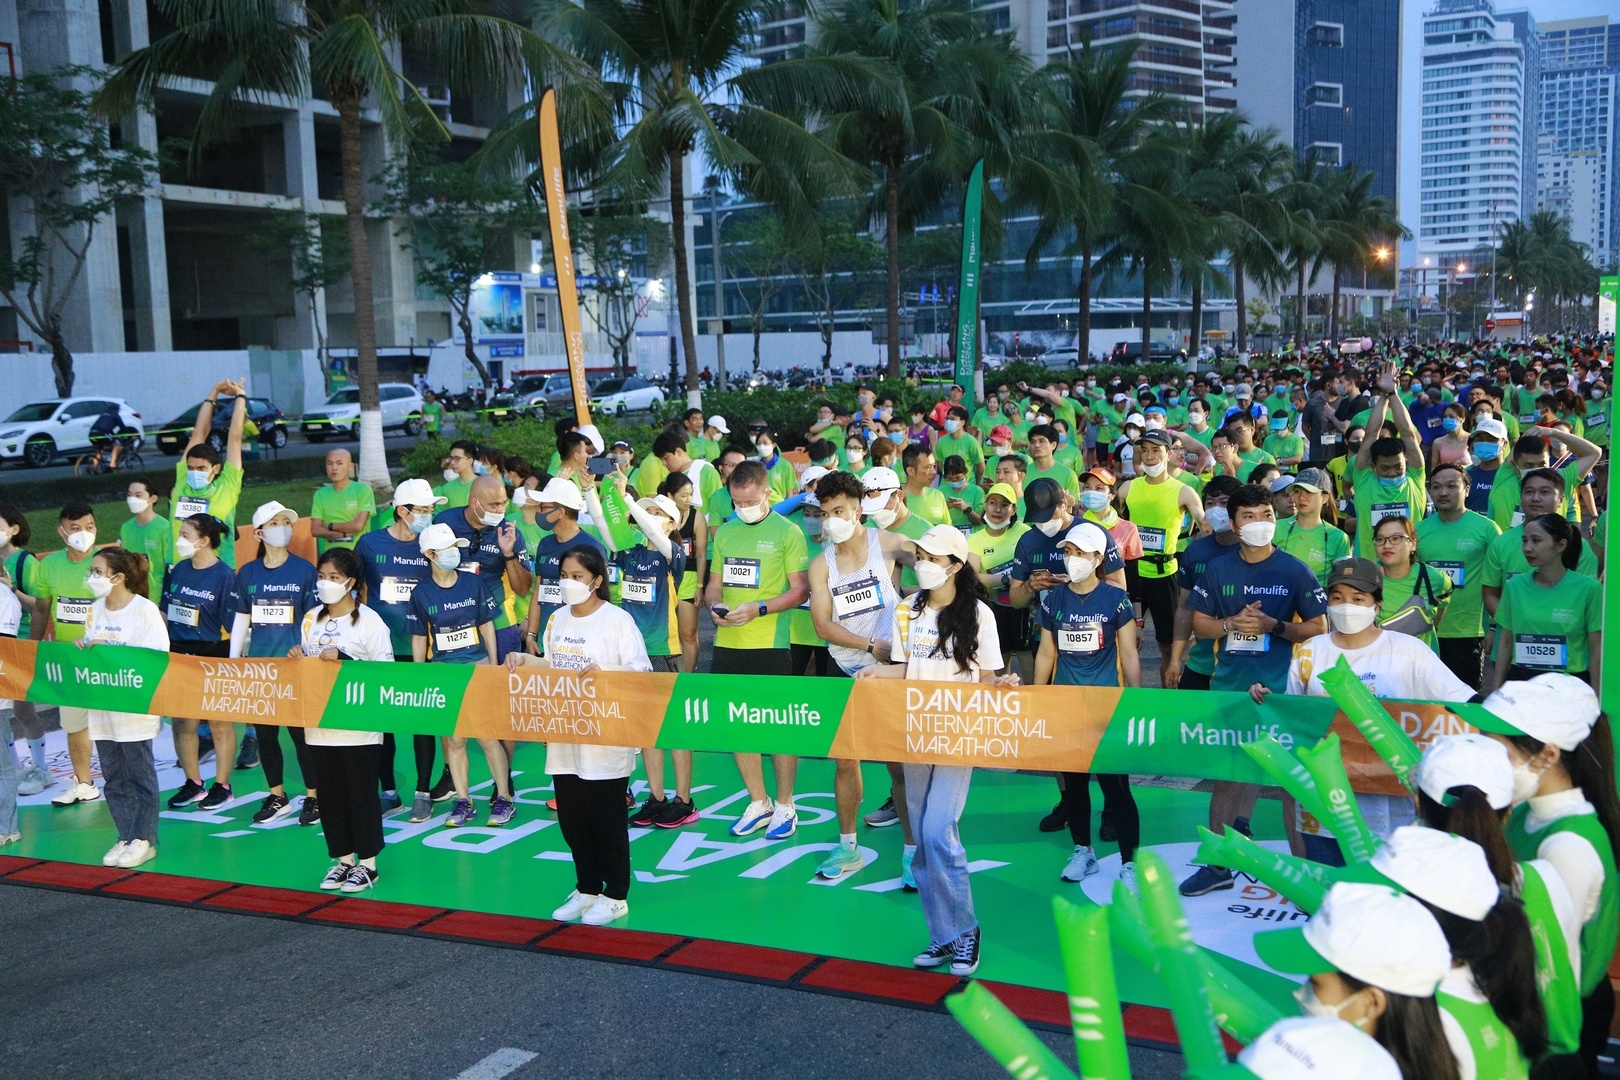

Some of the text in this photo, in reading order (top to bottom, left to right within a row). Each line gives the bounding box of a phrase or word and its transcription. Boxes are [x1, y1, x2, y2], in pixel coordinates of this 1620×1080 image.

[181, 504, 202, 512] 10380
[393, 556, 429, 567] Manulife
[730, 567, 751, 576] 10021
[181, 586, 215, 601] Manulife
[263, 583, 301, 593] Manulife
[628, 584, 647, 593] 10375
[1243, 585, 1289, 596] Manulife
[845, 590, 872, 604] 10010
[62, 605, 87, 614] 10080
[443, 597, 476, 611] Manulife
[175, 607, 192, 618] 11200
[262, 608, 284, 616] 11273
[1069, 613, 1108, 623] Manulife
[446, 632, 468, 643] 11272
[563, 636, 586, 645] Manulife
[1066, 633, 1093, 643] 10857
[552, 644, 584, 656] DANANG
[1525, 646, 1556, 656] 10528
[551, 653, 592, 664] INTERNATIONAL
[200, 661, 278, 681] DANANG
[75, 666, 144, 689] Manulife
[203, 678, 298, 701] INTERNATIONAL
[508, 673, 596, 698] DANANG
[379, 686, 447, 709] Manulife
[905, 687, 1022, 715] DANANG
[201, 696, 277, 717] MARATHON
[509, 696, 627, 720] INTERNATIONAL
[728, 701, 821, 727] Manulife
[511, 714, 602, 737] MARATHON
[905, 713, 1054, 740] INTERNATIONAL
[905, 733, 1019, 759] MARATHON
